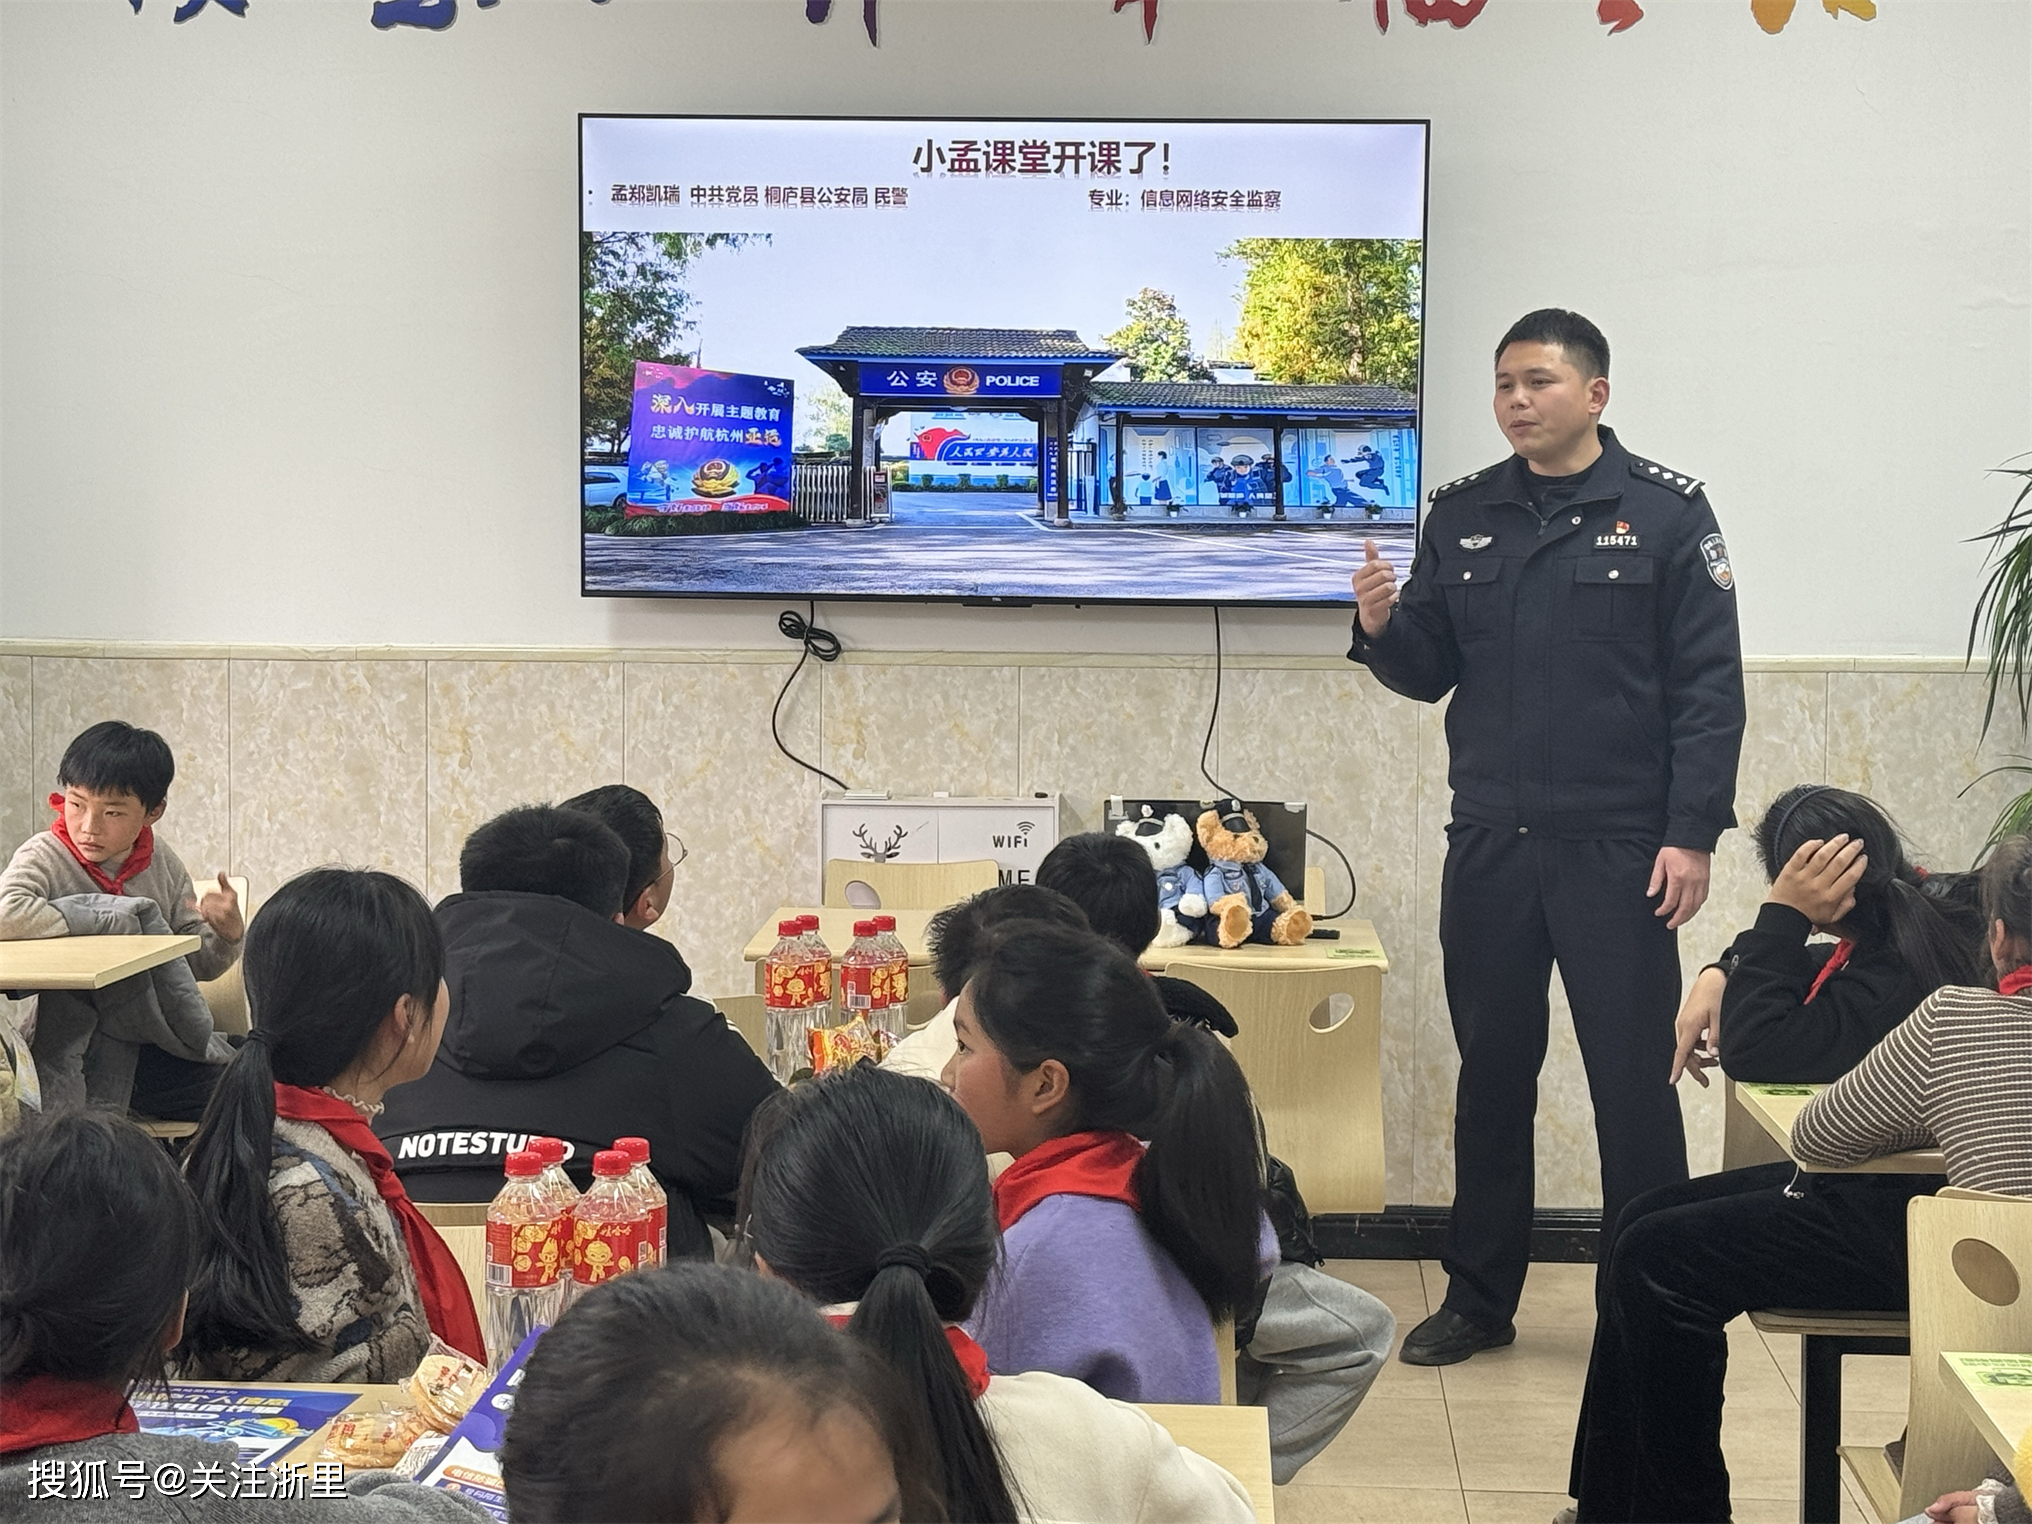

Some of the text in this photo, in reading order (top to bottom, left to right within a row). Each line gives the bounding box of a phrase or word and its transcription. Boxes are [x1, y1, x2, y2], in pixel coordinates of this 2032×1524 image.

[611, 184, 909, 207] 孟郑凯瑞 中共党员 桐庐县公安局 民警
[887, 370, 938, 388] 公安
[986, 375, 1040, 387] POLICE
[651, 394, 781, 421] 深入开展主题教育
[650, 424, 783, 447] 忠诚护航杭州亚运
[1595, 535, 1638, 546] 115471
[399, 1131, 576, 1161] NOTESTUO
